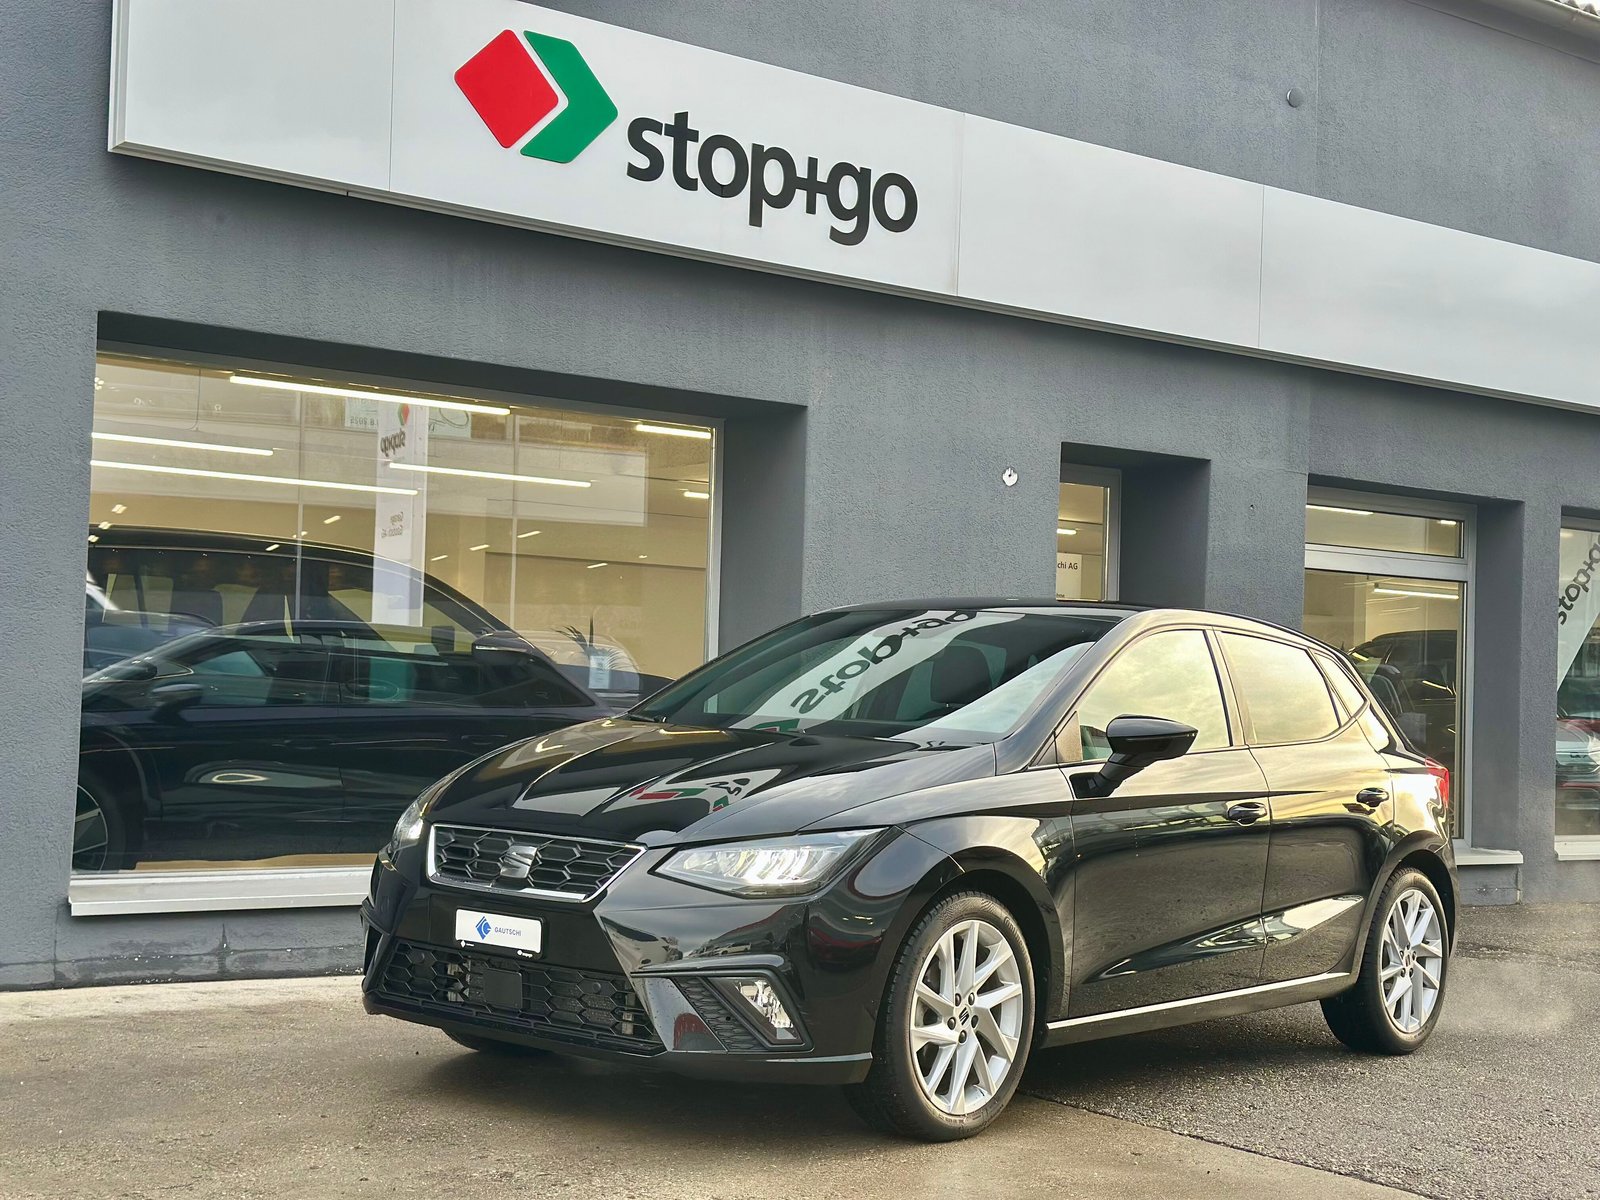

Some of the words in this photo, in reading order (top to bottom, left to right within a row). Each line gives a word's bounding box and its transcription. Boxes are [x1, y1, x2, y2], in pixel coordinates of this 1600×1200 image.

[626, 111, 918, 246] stop+go
[1068, 562, 1078, 570] AG
[494, 926, 521, 936] GAUTSCHI
